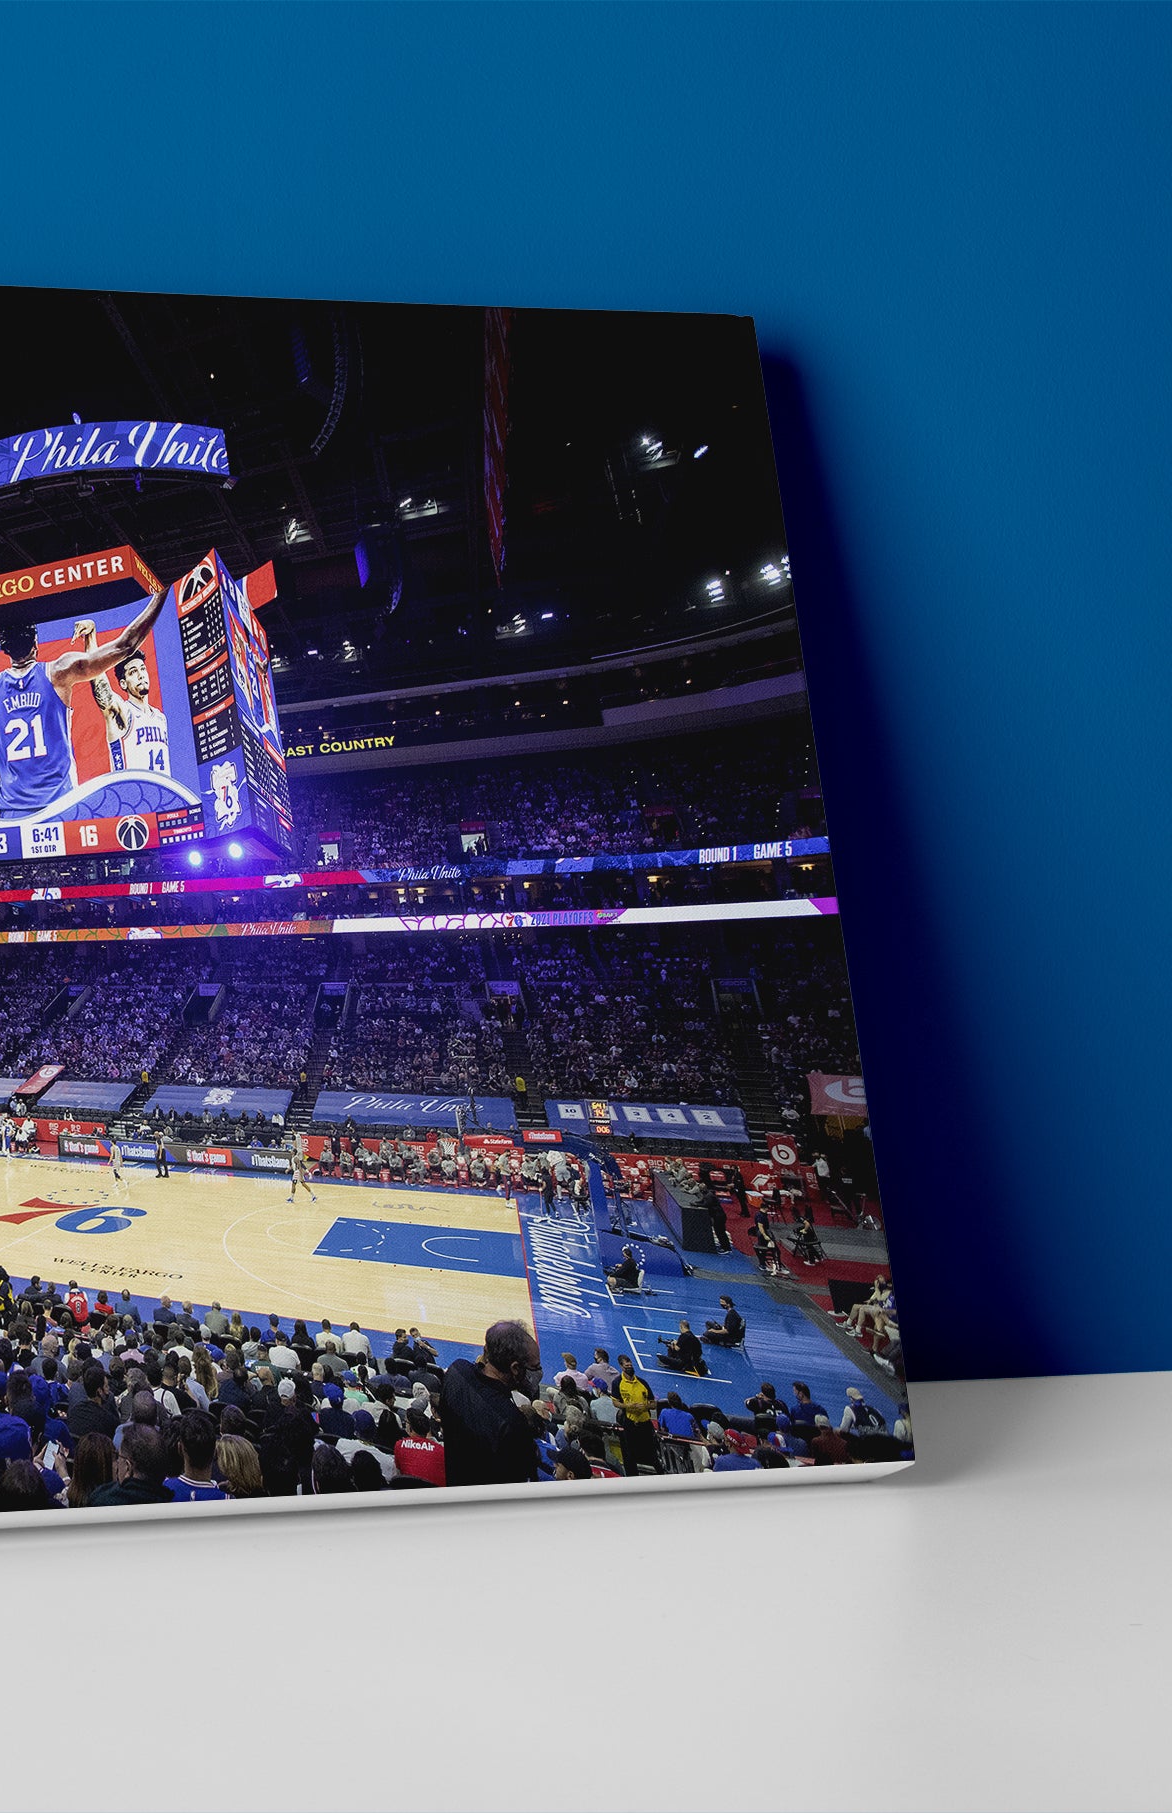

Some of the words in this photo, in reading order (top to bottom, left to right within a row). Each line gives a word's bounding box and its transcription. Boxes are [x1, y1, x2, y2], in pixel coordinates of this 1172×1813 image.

[10, 428, 120, 484] Phila
[39, 556, 124, 587] CENTER
[2, 692, 42, 714] EMBIID
[4, 714, 48, 762] 21
[320, 736, 395, 754] COUNTRY
[148, 748, 165, 770] 14
[32, 826, 60, 843] 6:41
[79, 825, 98, 847] 16
[30, 846, 43, 856] 1ST
[699, 846, 730, 864] ROUND
[732, 846, 737, 862] 1
[754, 843, 783, 860] GAME
[785, 842, 792, 857] 5
[398, 866, 430, 882] Phila
[430, 865, 462, 880] Unite
[130, 882, 148, 895] ROUND
[148, 882, 153, 894] 1
[162, 882, 179, 894] GAME
[180, 880, 185, 892] 5
[506, 914, 524, 928] 76
[530, 913, 550, 926] 2021
[552, 912, 594, 926] PLAYOFFS
[36, 930, 52, 942] GAME
[241, 922, 270, 936] Phila
[270, 922, 298, 934] Unite
[344, 1095, 415, 1111] Phila
[72, 1141, 86, 1152] that's
[85, 1142, 99, 1154] game
[192, 1150, 210, 1162] that's
[210, 1153, 226, 1164] game
[53, 1257, 116, 1270] WELLS
[122, 1266, 184, 1280] FARGO
[81, 1267, 138, 1279] CENTER
[401, 1440, 436, 1452] NikeAir
